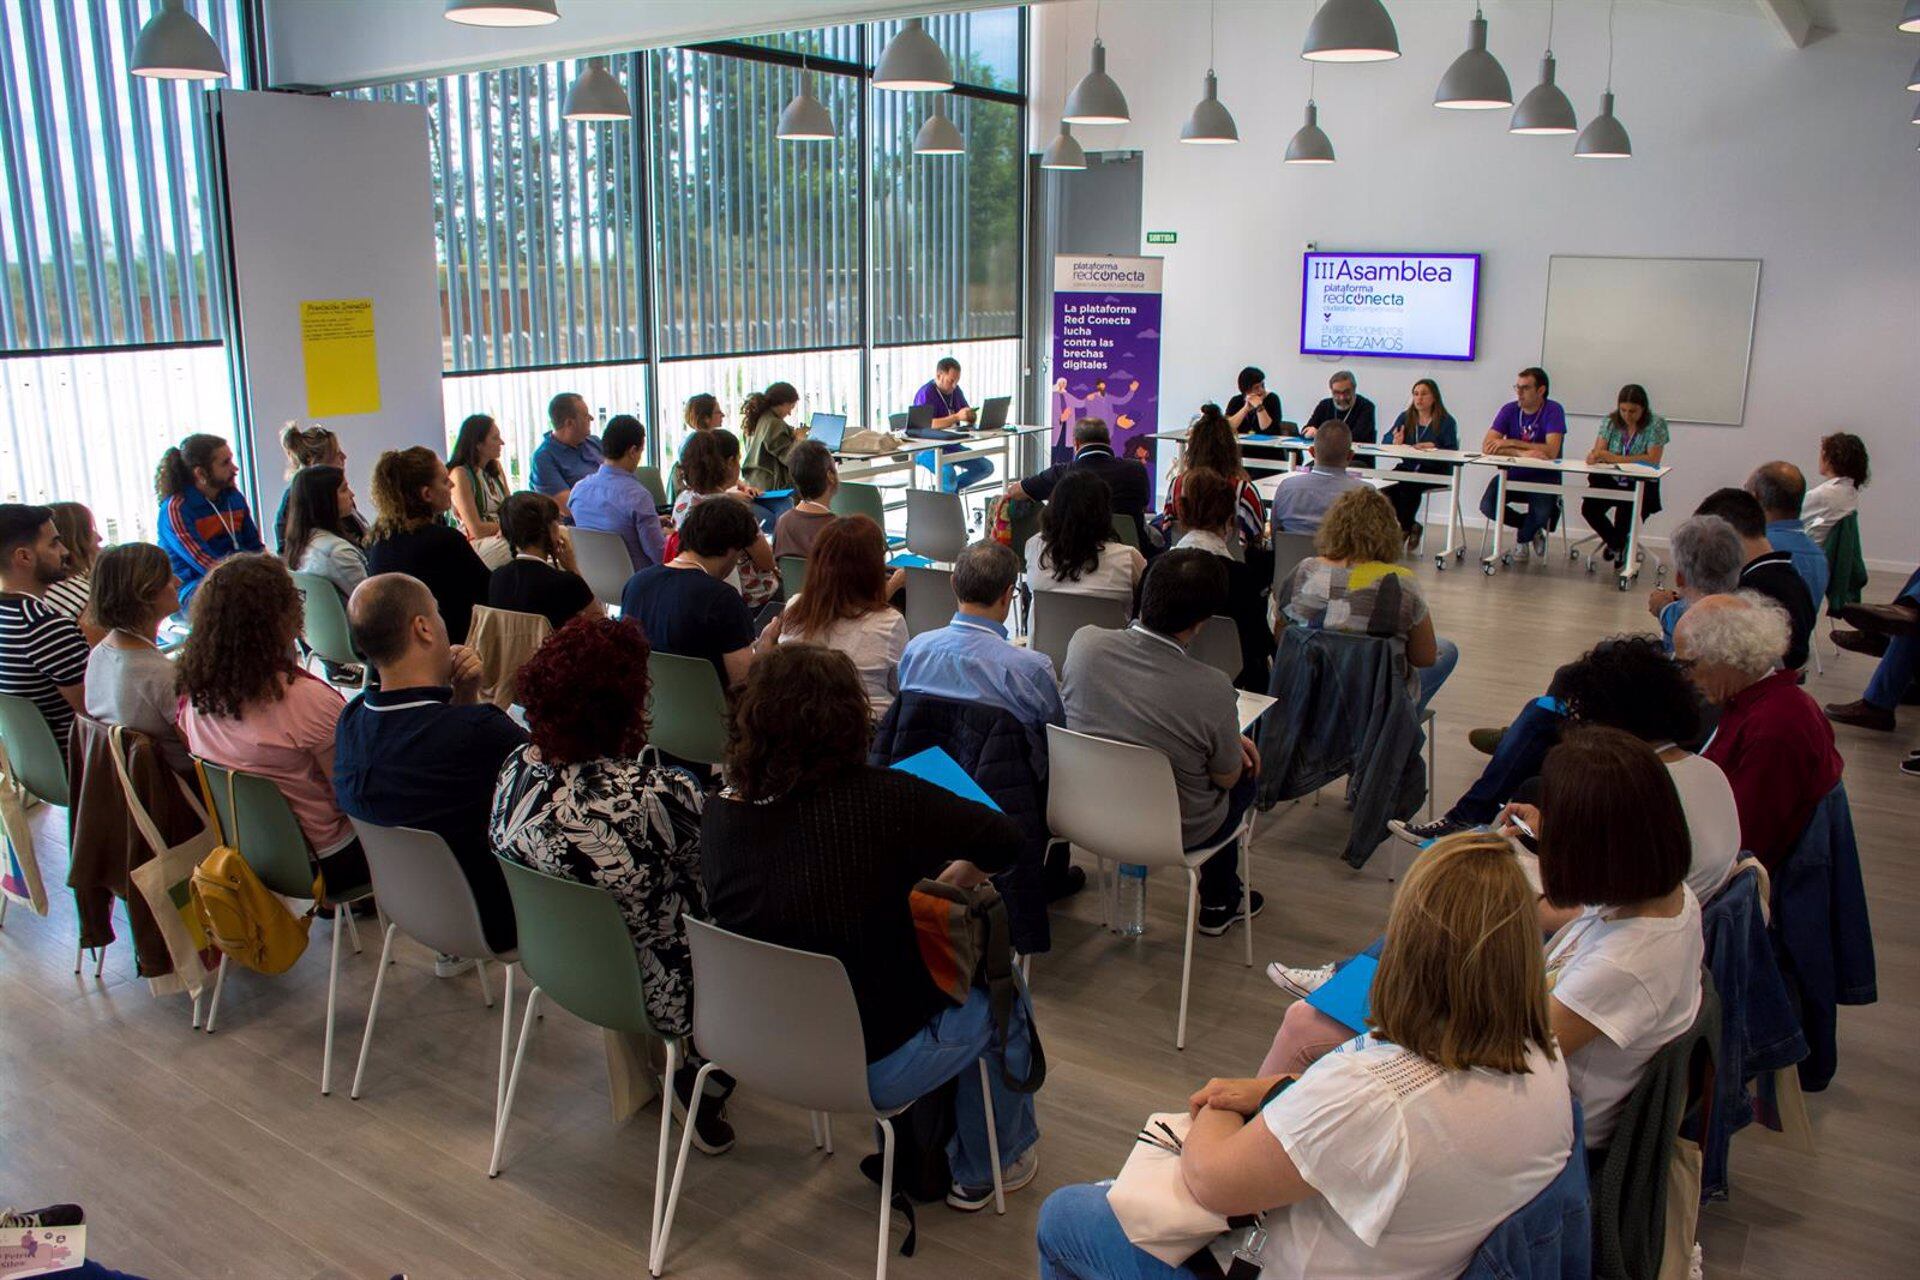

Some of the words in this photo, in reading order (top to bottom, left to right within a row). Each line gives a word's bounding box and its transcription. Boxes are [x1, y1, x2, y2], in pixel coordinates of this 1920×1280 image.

[1073, 262, 1118, 271] plataforma
[1314, 262, 1334, 280] III
[1336, 259, 1452, 282] Asamblea
[1073, 270, 1145, 282] redconecta
[1324, 283, 1374, 294] plataforma
[1323, 292, 1404, 306] redconecta
[1064, 304, 1077, 313] La
[1079, 304, 1137, 315] plataforma
[1064, 315, 1085, 325] Red
[1087, 315, 1131, 325] Conecta
[1064, 327, 1092, 336] lucha
[1063, 338, 1097, 347] contra
[1099, 338, 1114, 347] las
[1321, 335, 1404, 351] EMPEZAMOS
[1063, 349, 1104, 358] brechas
[1062, 360, 1108, 370] digitales
